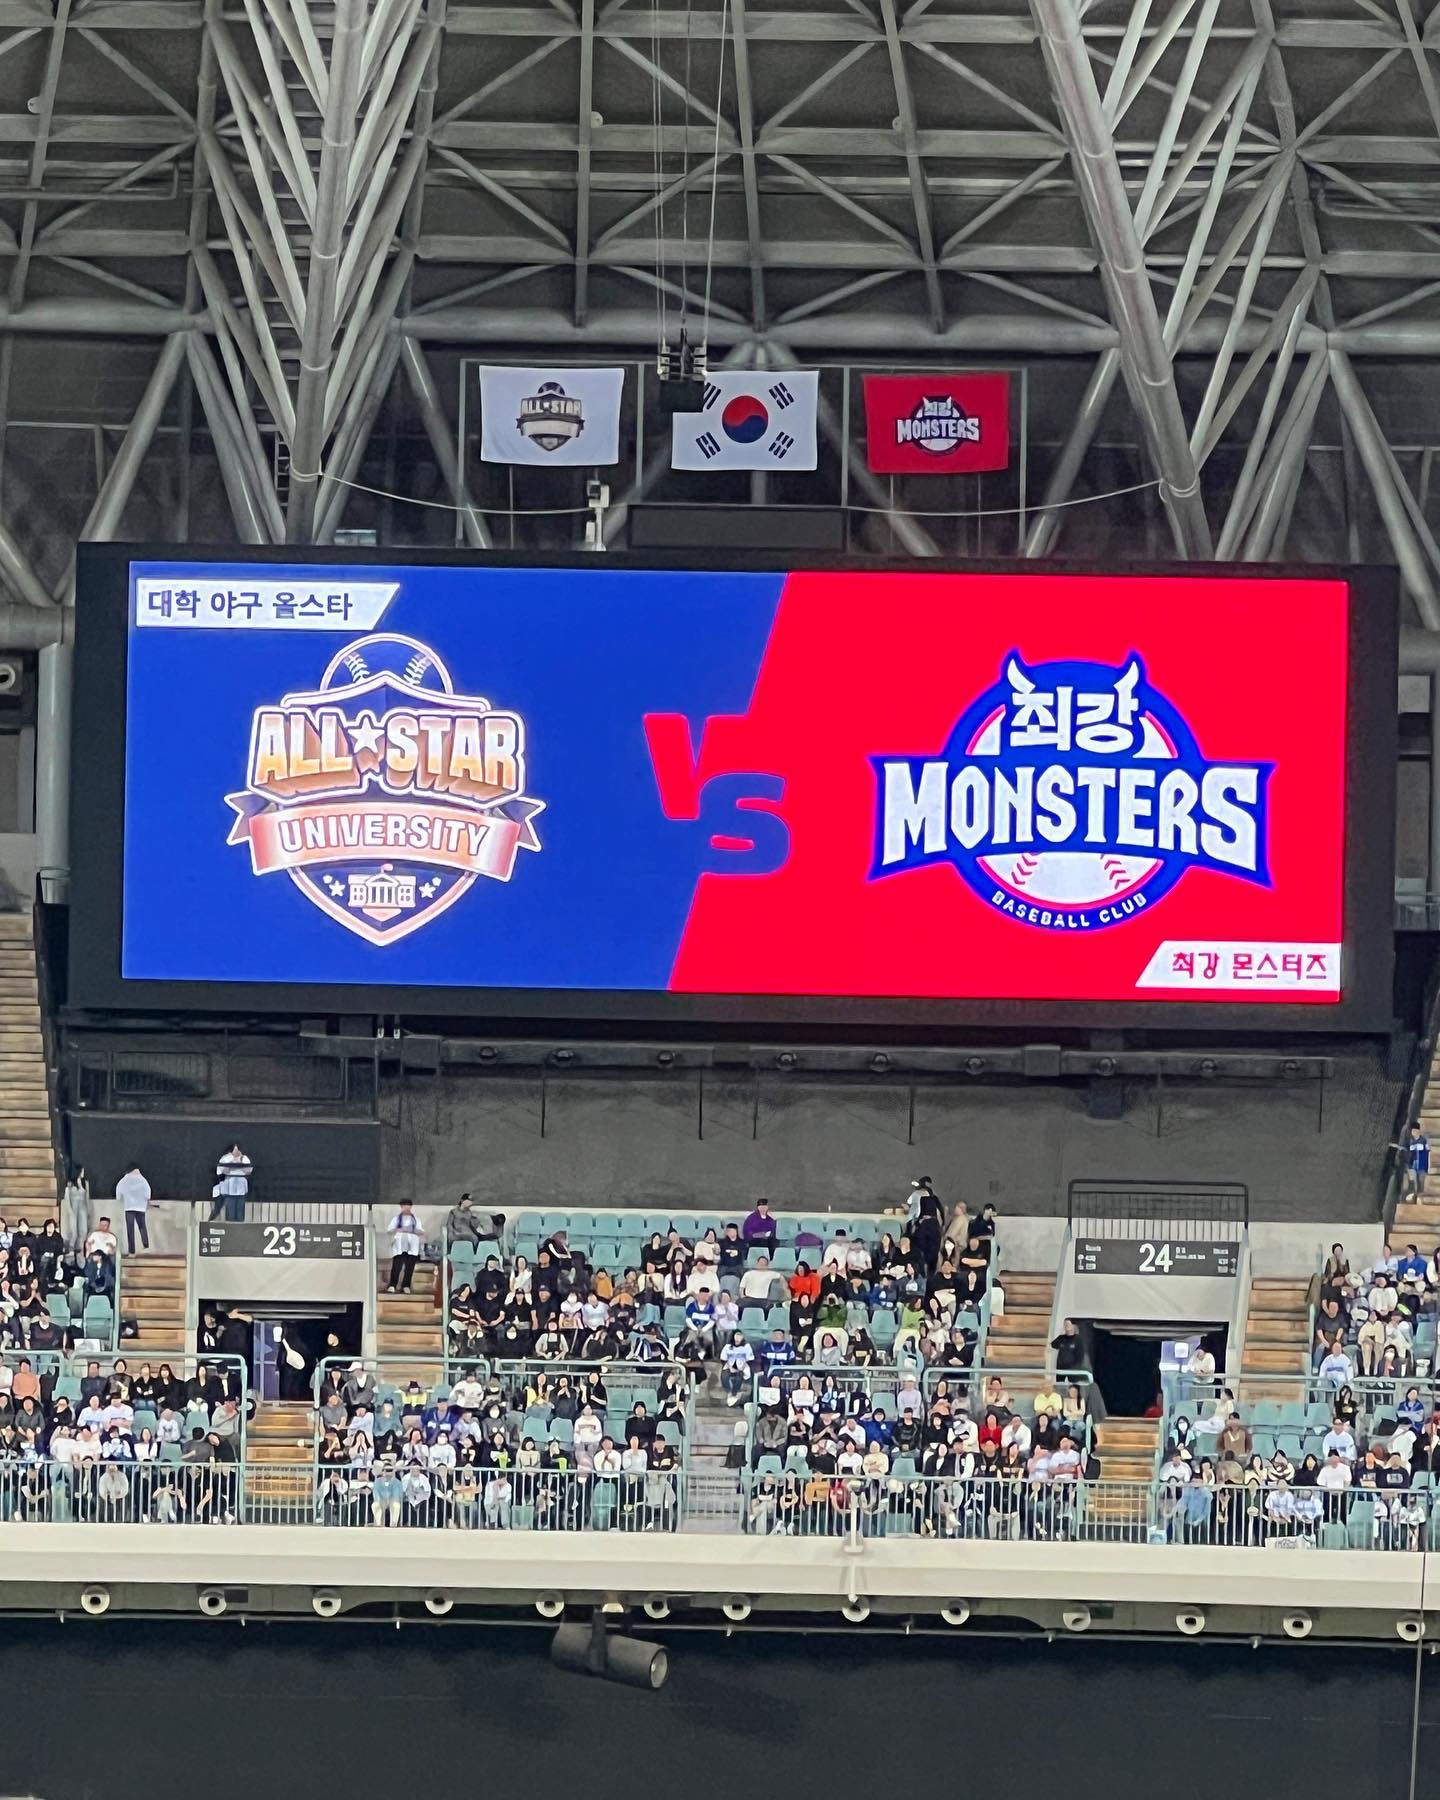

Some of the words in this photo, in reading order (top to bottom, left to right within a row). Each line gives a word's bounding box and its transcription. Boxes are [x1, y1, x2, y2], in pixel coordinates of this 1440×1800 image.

[897, 418, 980, 443] MONSTERS
[148, 589, 201, 619] 대학
[211, 591, 263, 619] 야구
[272, 591, 354, 621] 올스타
[1007, 658, 1139, 755] 최강
[255, 713, 355, 784] ALL
[386, 715, 519, 792] STAR
[644, 713, 792, 876] VS
[882, 761, 1259, 872] MONSTERS
[278, 814, 491, 857] UNIVERSITY
[991, 891, 1090, 928] BASEBALL
[1099, 893, 1147, 924] CLUB
[1172, 952, 1221, 980] 최강
[1233, 953, 1328, 981] 몬스터즈
[263, 1226, 296, 1256] 23
[1139, 1242, 1173, 1273] 24
